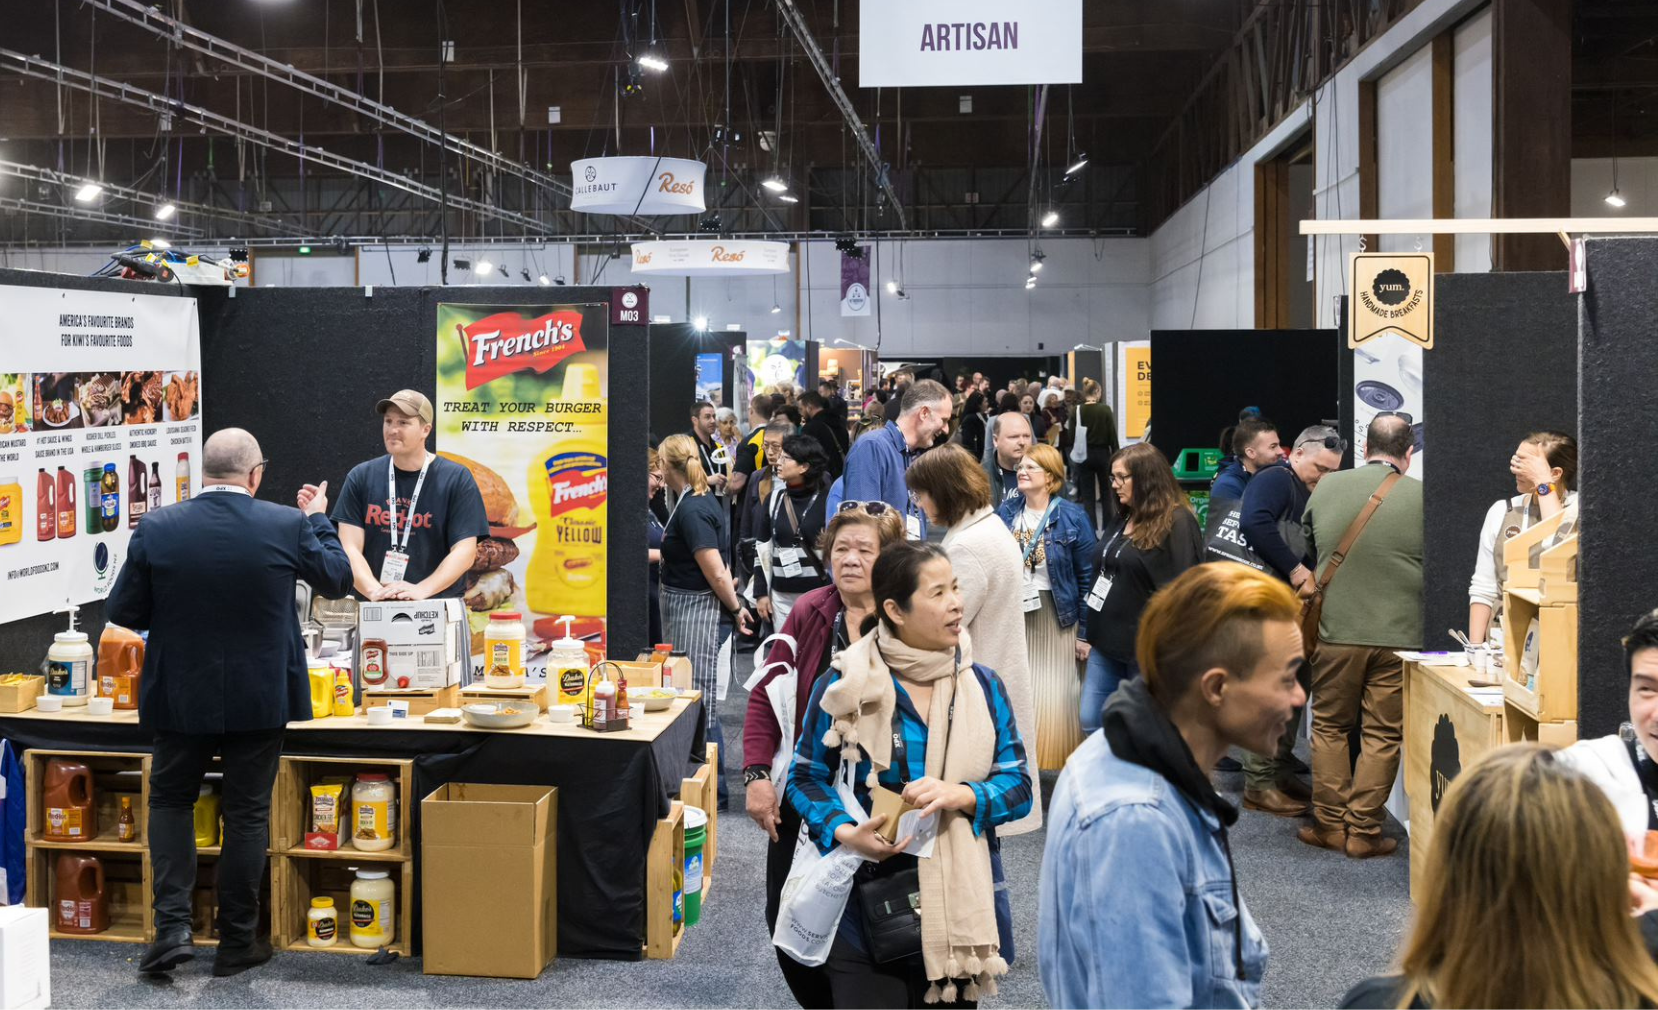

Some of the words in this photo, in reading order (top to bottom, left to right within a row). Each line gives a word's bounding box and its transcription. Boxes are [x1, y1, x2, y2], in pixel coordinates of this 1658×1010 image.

[920, 21, 1018, 51] ARTISAN
[575, 182, 617, 195] CALLEBAUT
[658, 171, 695, 195] Resó
[711, 245, 746, 262] Resó
[1378, 282, 1405, 293] yum.
[1359, 290, 1389, 319] HANDMADE
[1390, 288, 1424, 319] BREAKFASTS
[59, 314, 87, 328] AMERICA'S
[88, 315, 114, 328] FAVOURITE
[114, 316, 134, 329] BRANDS
[61, 334, 71, 346] FOR
[72, 334, 90, 347] KIWI'S
[90, 335, 116, 347] FAVOURITE
[117, 335, 132, 347] FOODS
[471, 319, 574, 367] French's
[443, 402, 490, 413] TREAT
[499, 402, 535, 413] YOUR
[545, 402, 602, 414] BURGER
[461, 421, 499, 432] WITH
[556, 526, 602, 544] YELLOW
[414, 611, 438, 619] KETCHUP
